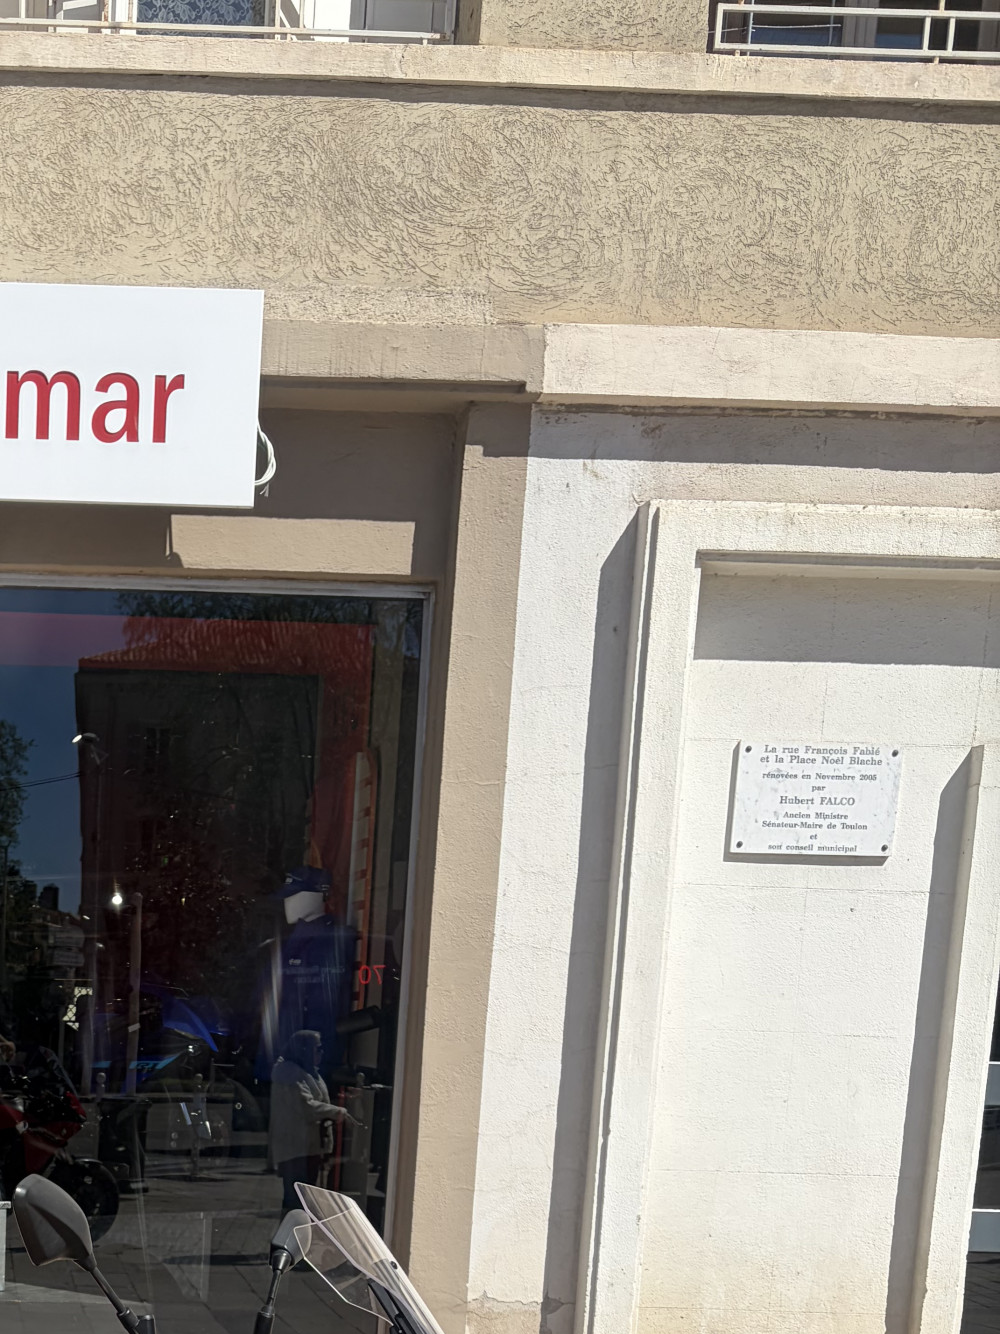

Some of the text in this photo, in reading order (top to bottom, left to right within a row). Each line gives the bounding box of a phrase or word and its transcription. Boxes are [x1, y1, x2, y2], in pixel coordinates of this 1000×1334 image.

[764, 745, 777, 753] La
[805, 746, 848, 755] François
[853, 746, 880, 755] Fabié
[774, 755, 784, 763] la
[789, 755, 816, 764] Place
[821, 756, 844, 765] Noël
[850, 757, 882, 766] Blache
[815, 773, 855, 781] Novembre
[779, 796, 855, 806] Hubert FALCO
[783, 811, 848, 820] Ancien Ministre
[762, 820, 823, 829] Sénateur-Maire
[818, 845, 857, 853] municipal
